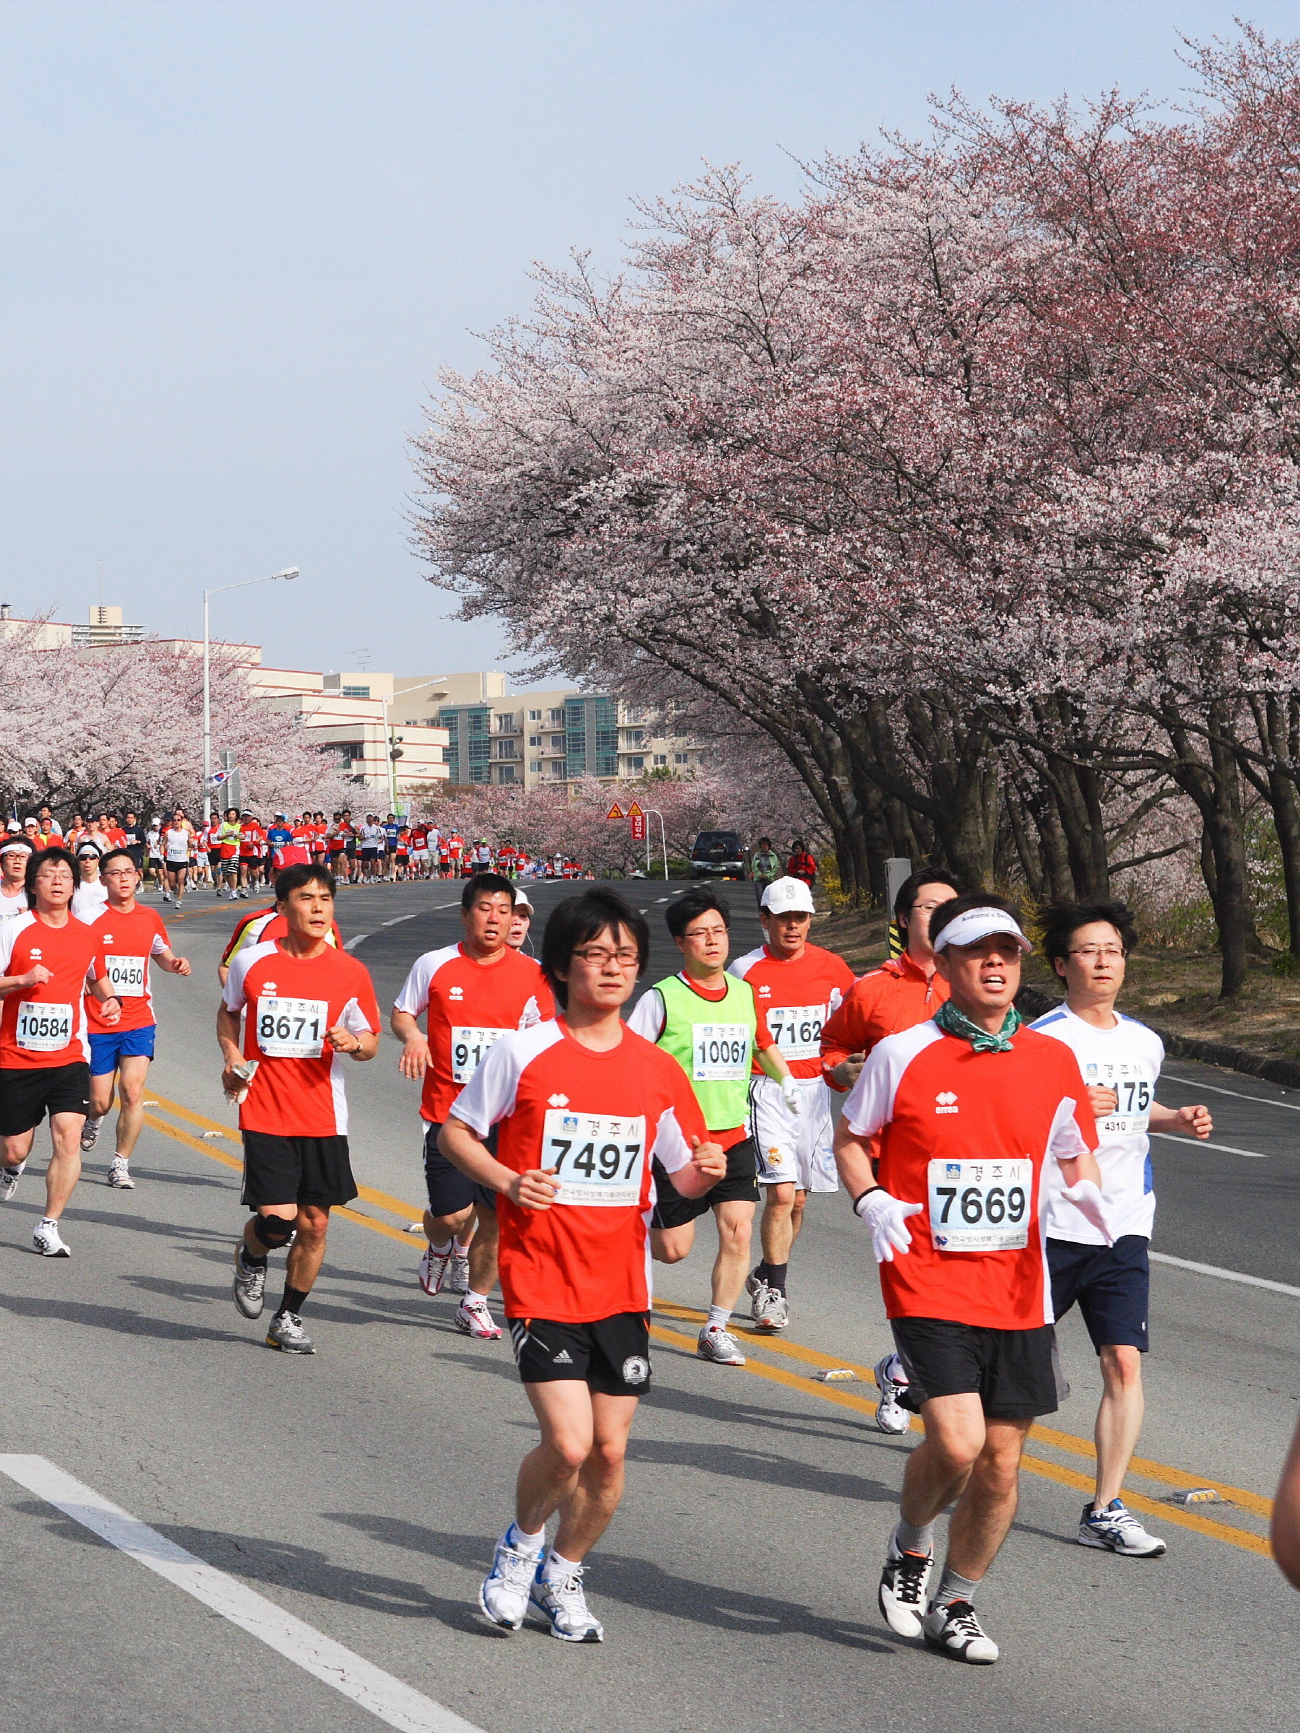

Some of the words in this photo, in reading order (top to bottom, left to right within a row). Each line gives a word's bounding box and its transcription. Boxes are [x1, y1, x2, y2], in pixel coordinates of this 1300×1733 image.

[785, 884, 796, 900] S
[38, 1005, 67, 1016] 경주시
[284, 1001, 320, 1014] 경주시
[21, 1015, 69, 1037] 10584
[260, 1014, 320, 1041] 8671
[717, 1027, 745, 1038] 경주시
[770, 1020, 822, 1044] 7162
[455, 1043, 492, 1067] 91
[698, 1040, 746, 1064] 10061
[1103, 1064, 1143, 1078] 경주시
[1086, 1081, 1150, 1112] 175
[935, 1105, 959, 1114] errea
[587, 1119, 639, 1138] 경주시
[1104, 1121, 1126, 1132] 4310
[551, 1138, 641, 1180] 7497
[970, 1164, 1020, 1182] 경주시
[935, 1186, 1026, 1224] 7669
